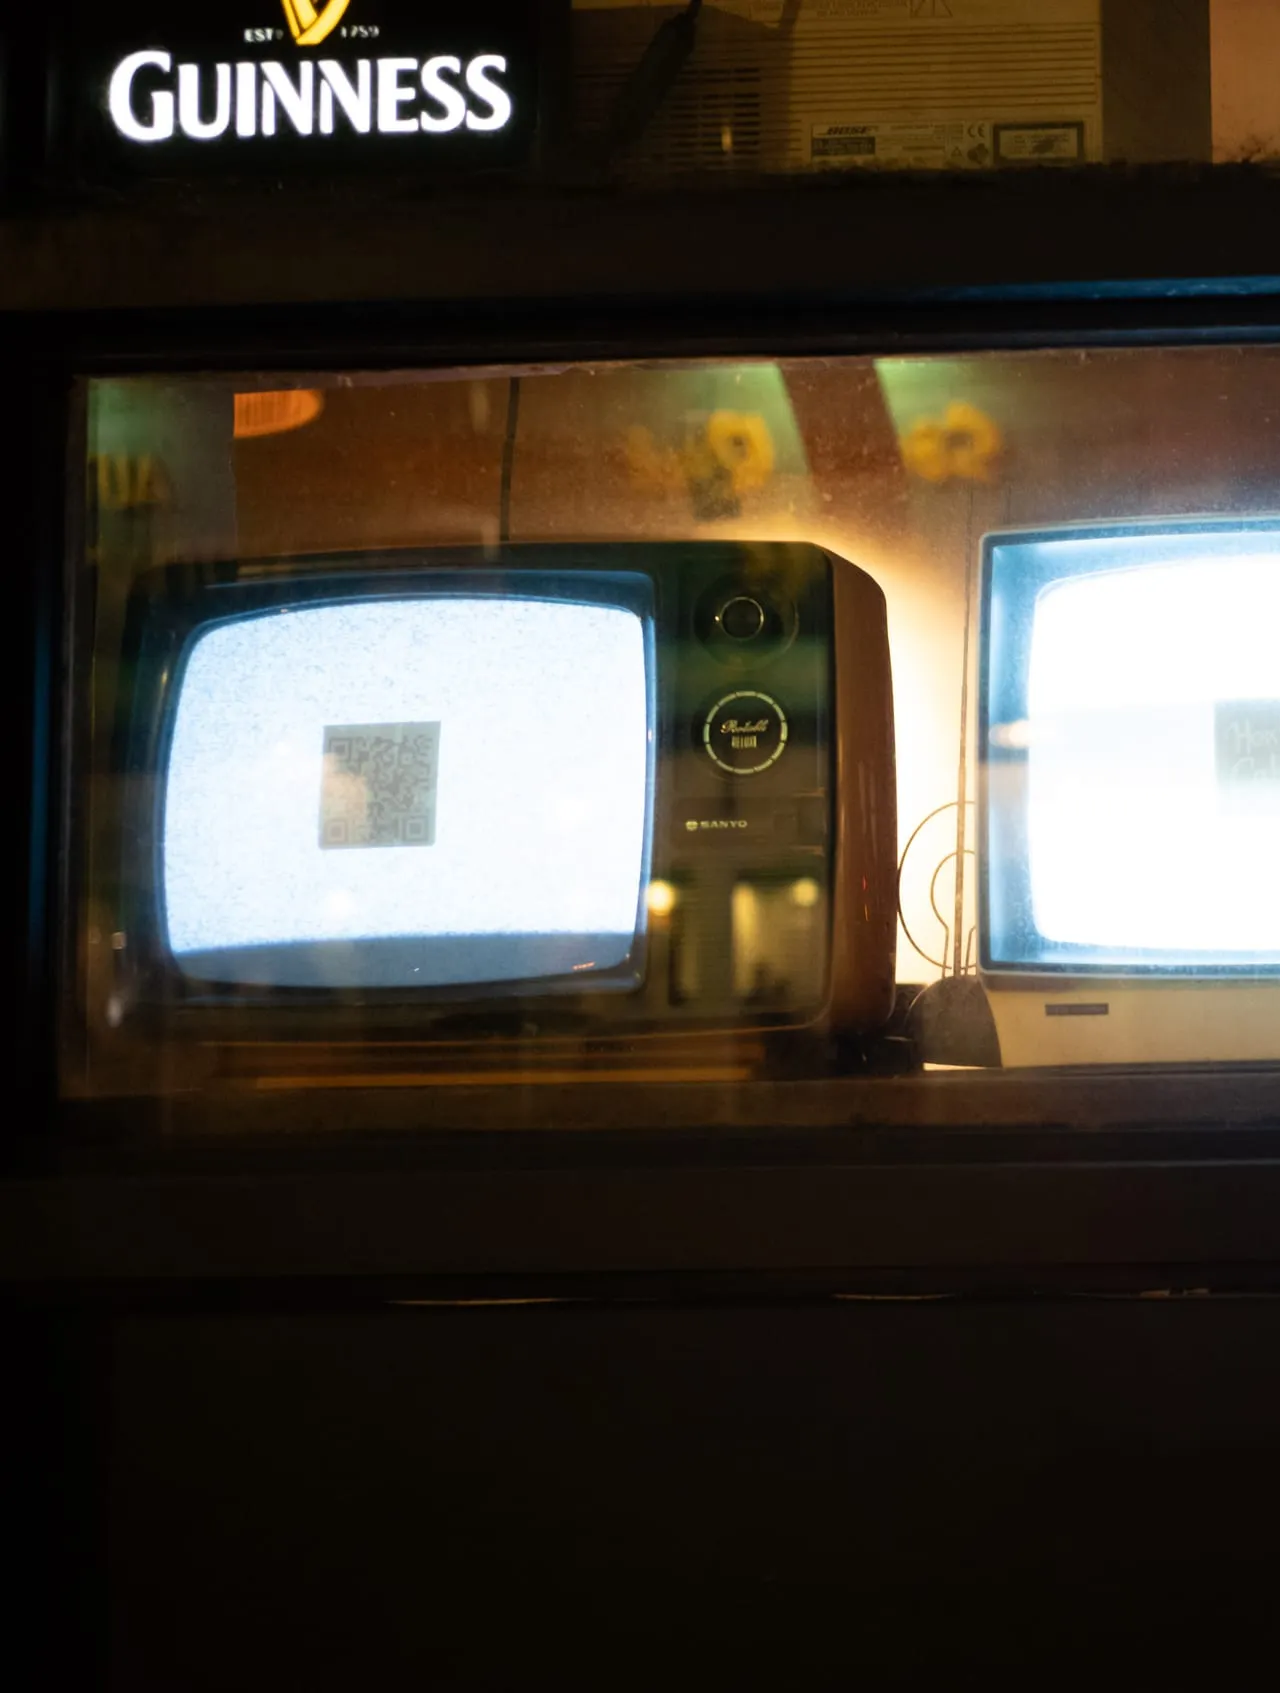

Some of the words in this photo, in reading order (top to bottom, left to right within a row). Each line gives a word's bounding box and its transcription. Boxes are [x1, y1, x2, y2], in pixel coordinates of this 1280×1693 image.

[341, 24, 380, 39] 1759
[107, 49, 513, 142] GUINNESS
[700, 819, 749, 829] SANYO
